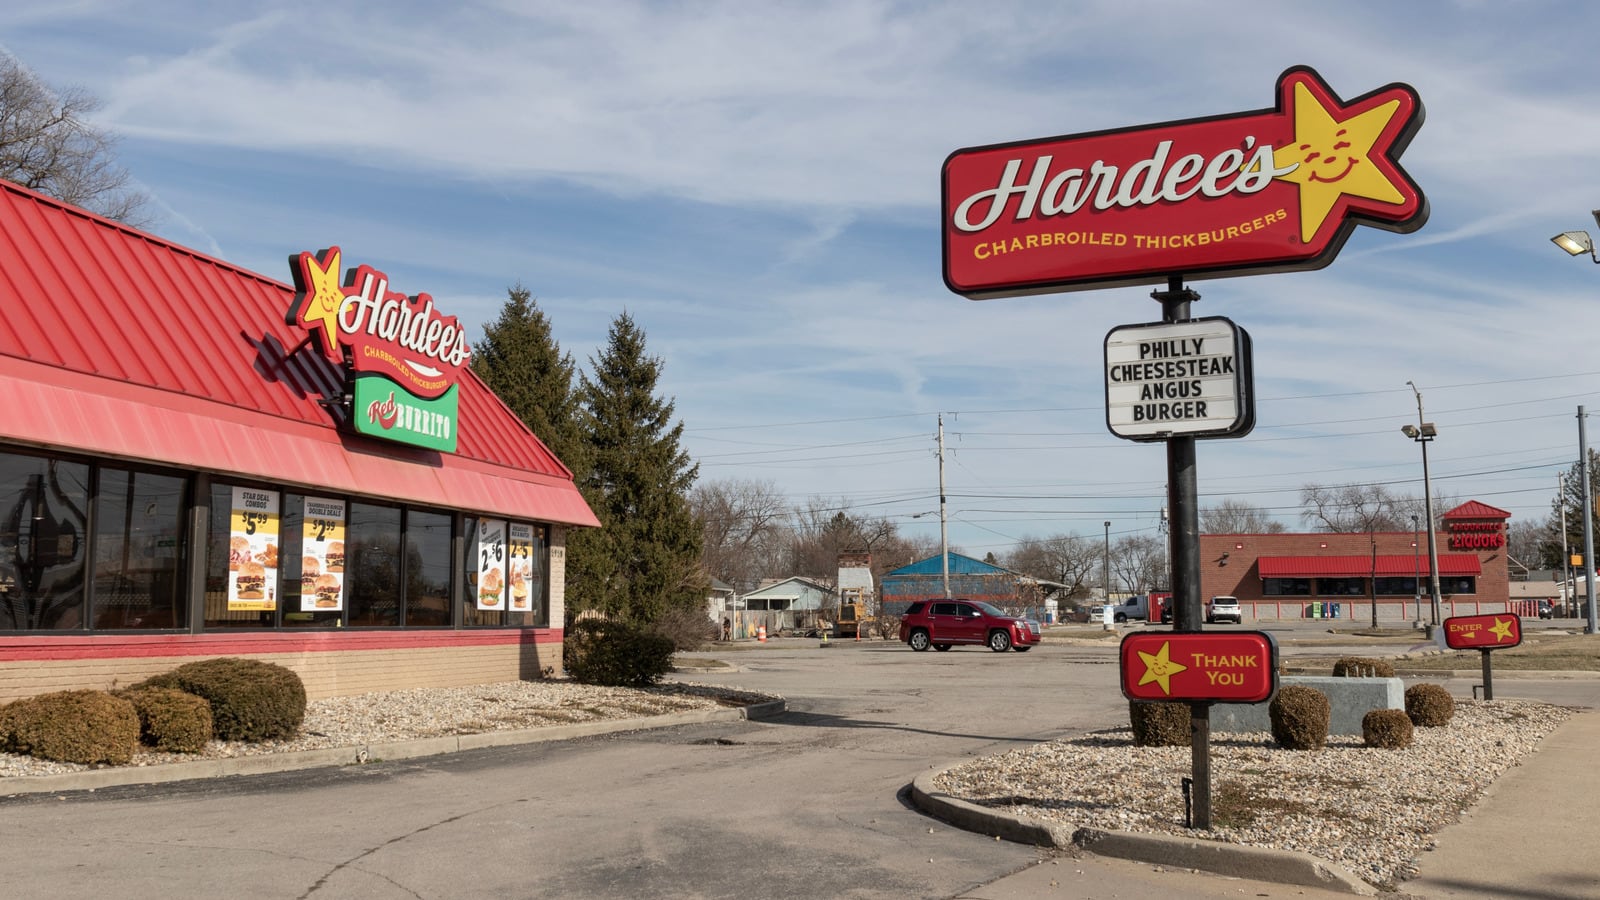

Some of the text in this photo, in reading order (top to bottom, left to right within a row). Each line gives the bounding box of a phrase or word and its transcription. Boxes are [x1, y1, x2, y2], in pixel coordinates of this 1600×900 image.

[953, 135, 1300, 233] Hardee's
[973, 208, 1288, 260] CHARBROILED THICKBURGERS
[338, 273, 471, 367] Hardee's
[1139, 338, 1204, 360] PHILLY
[364, 345, 447, 390] CHARBROILED THICKBURGERS
[1110, 356, 1234, 382] CHEESESTEAK
[1141, 380, 1202, 400] ANGUS
[367, 391, 450, 440] Red BURRITO
[1133, 400, 1207, 421] BURGER
[242, 492, 256, 500] STAR
[245, 500, 267, 509] COMBOS
[1453, 532, 1505, 548] LIQUORS
[1450, 623, 1483, 632] ENTER
[1191, 653, 1258, 668] THANK
[1206, 671, 1244, 686] YOU
